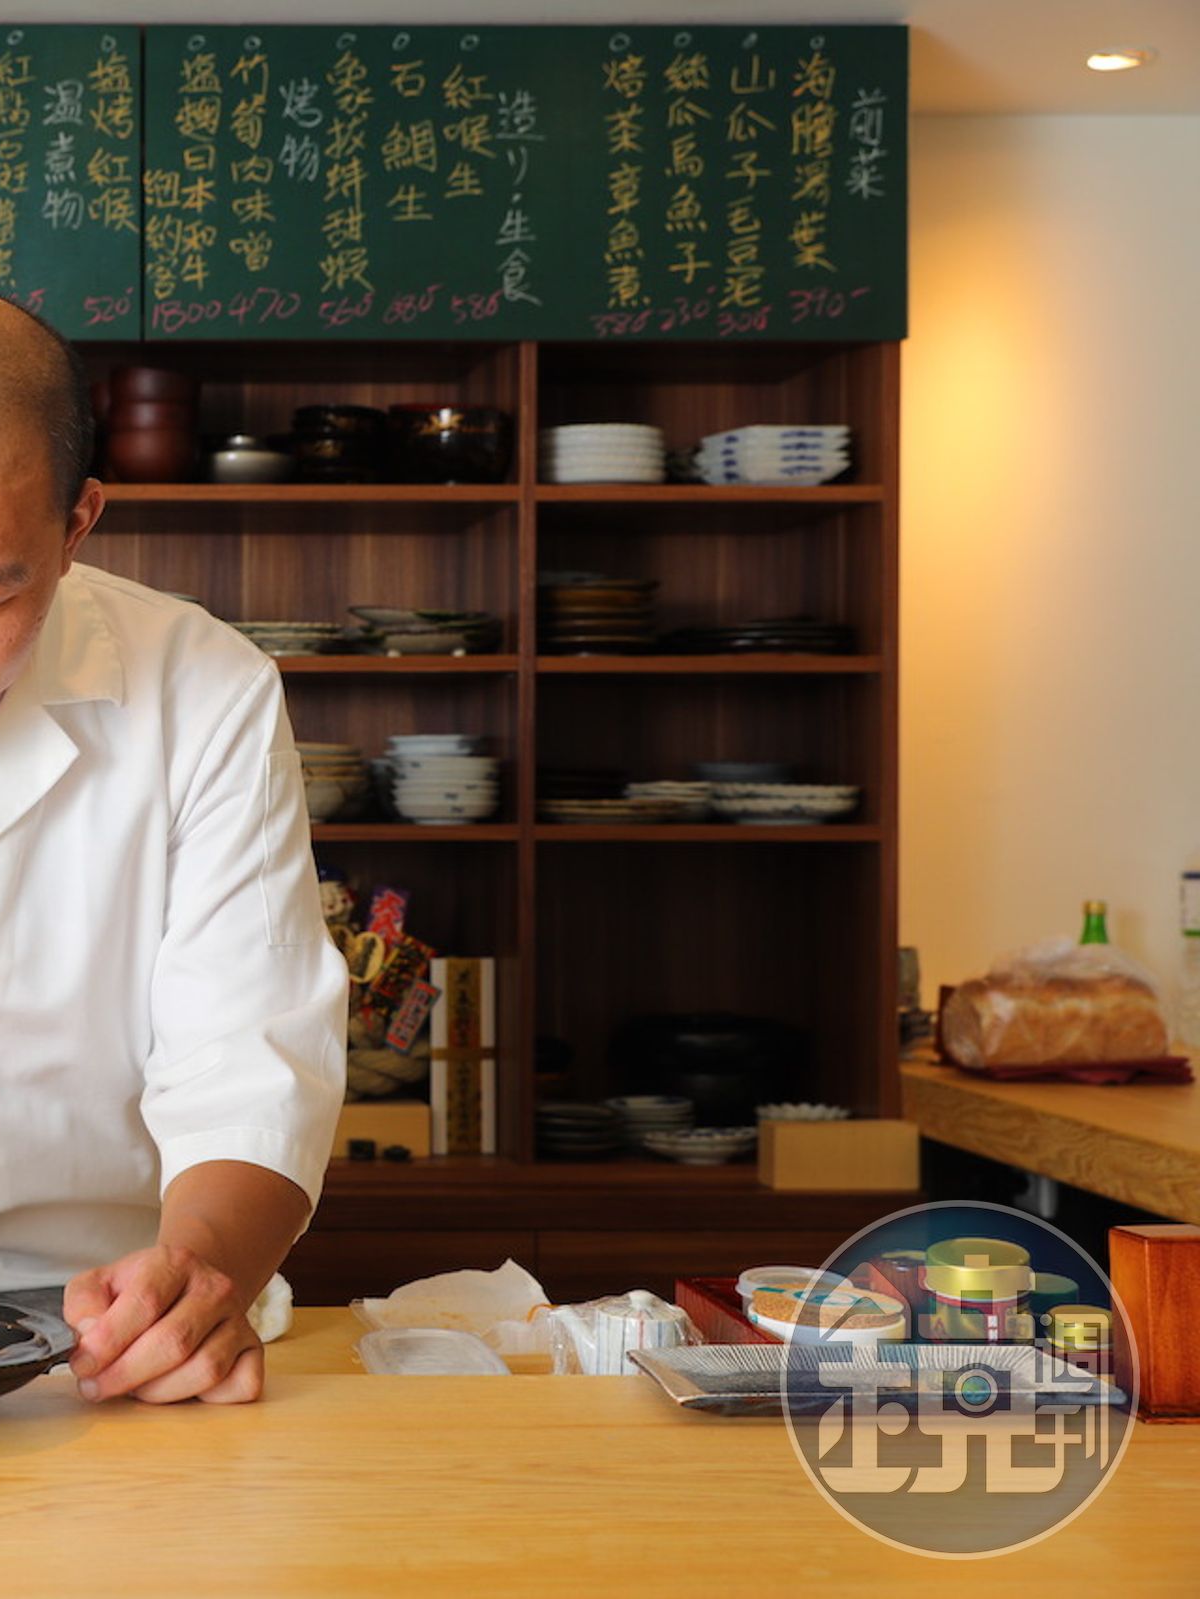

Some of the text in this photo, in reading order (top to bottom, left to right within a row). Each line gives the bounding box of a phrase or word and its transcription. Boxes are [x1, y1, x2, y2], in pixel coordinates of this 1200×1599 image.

[229, 54, 276, 272] 竹筍肉味噌
[381, 61, 438, 222] 石鯛生
[442, 63, 496, 199] 紅喉生
[845, 87, 887, 199] 前菜
